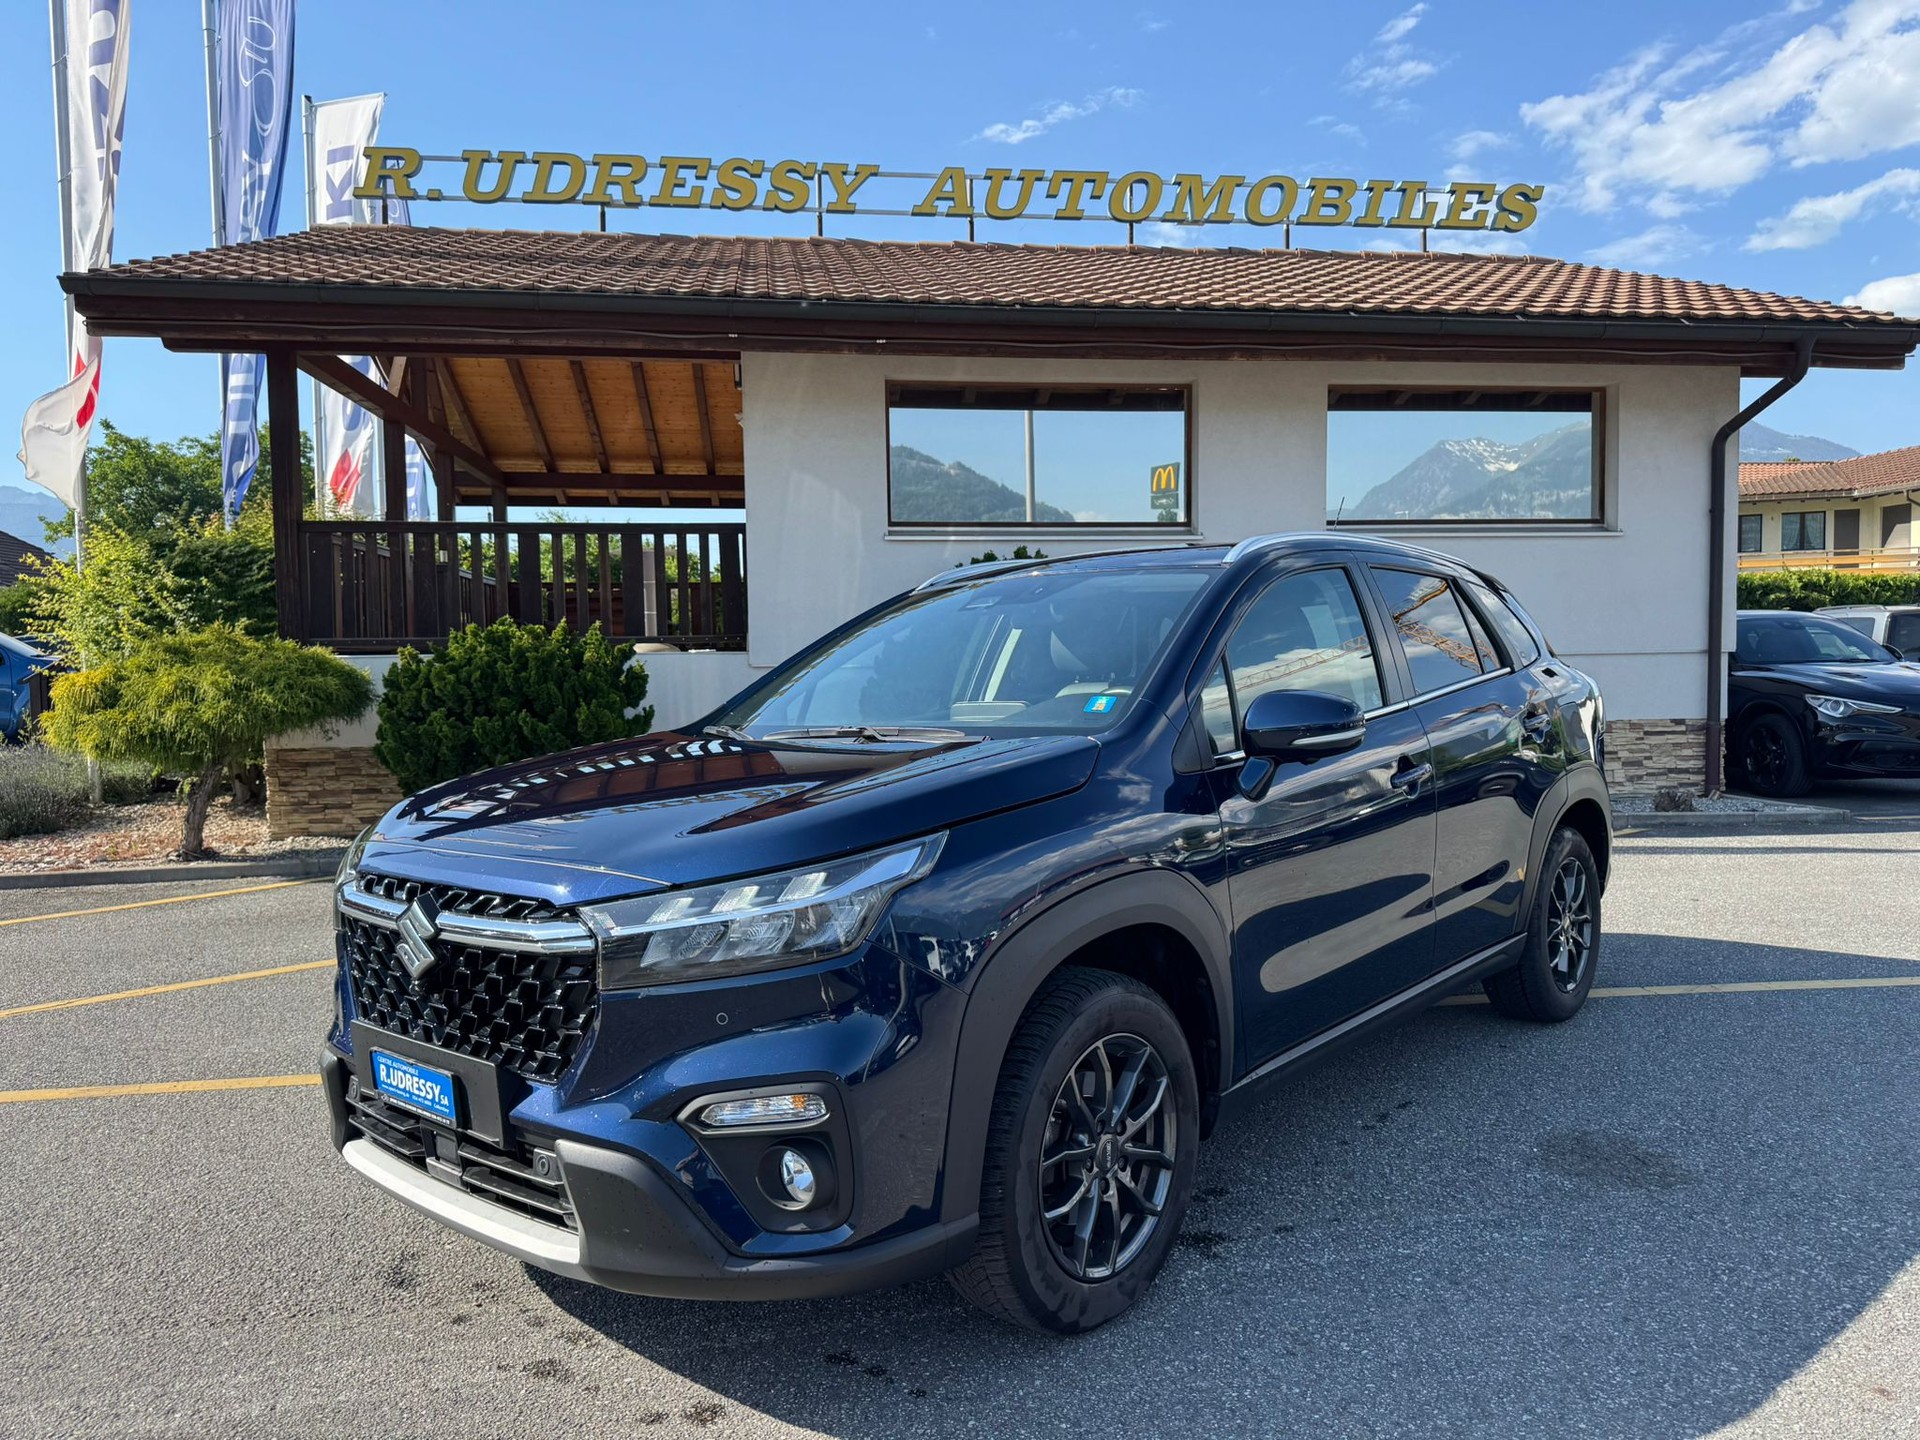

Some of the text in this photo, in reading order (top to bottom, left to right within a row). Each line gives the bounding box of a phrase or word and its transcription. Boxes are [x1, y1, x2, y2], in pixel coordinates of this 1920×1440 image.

[353, 146, 1545, 233] R.UDRESSY AUTOMOBILES
[380, 1064, 441, 1103] R.UDRESSY
[440, 1094, 449, 1107] SA
